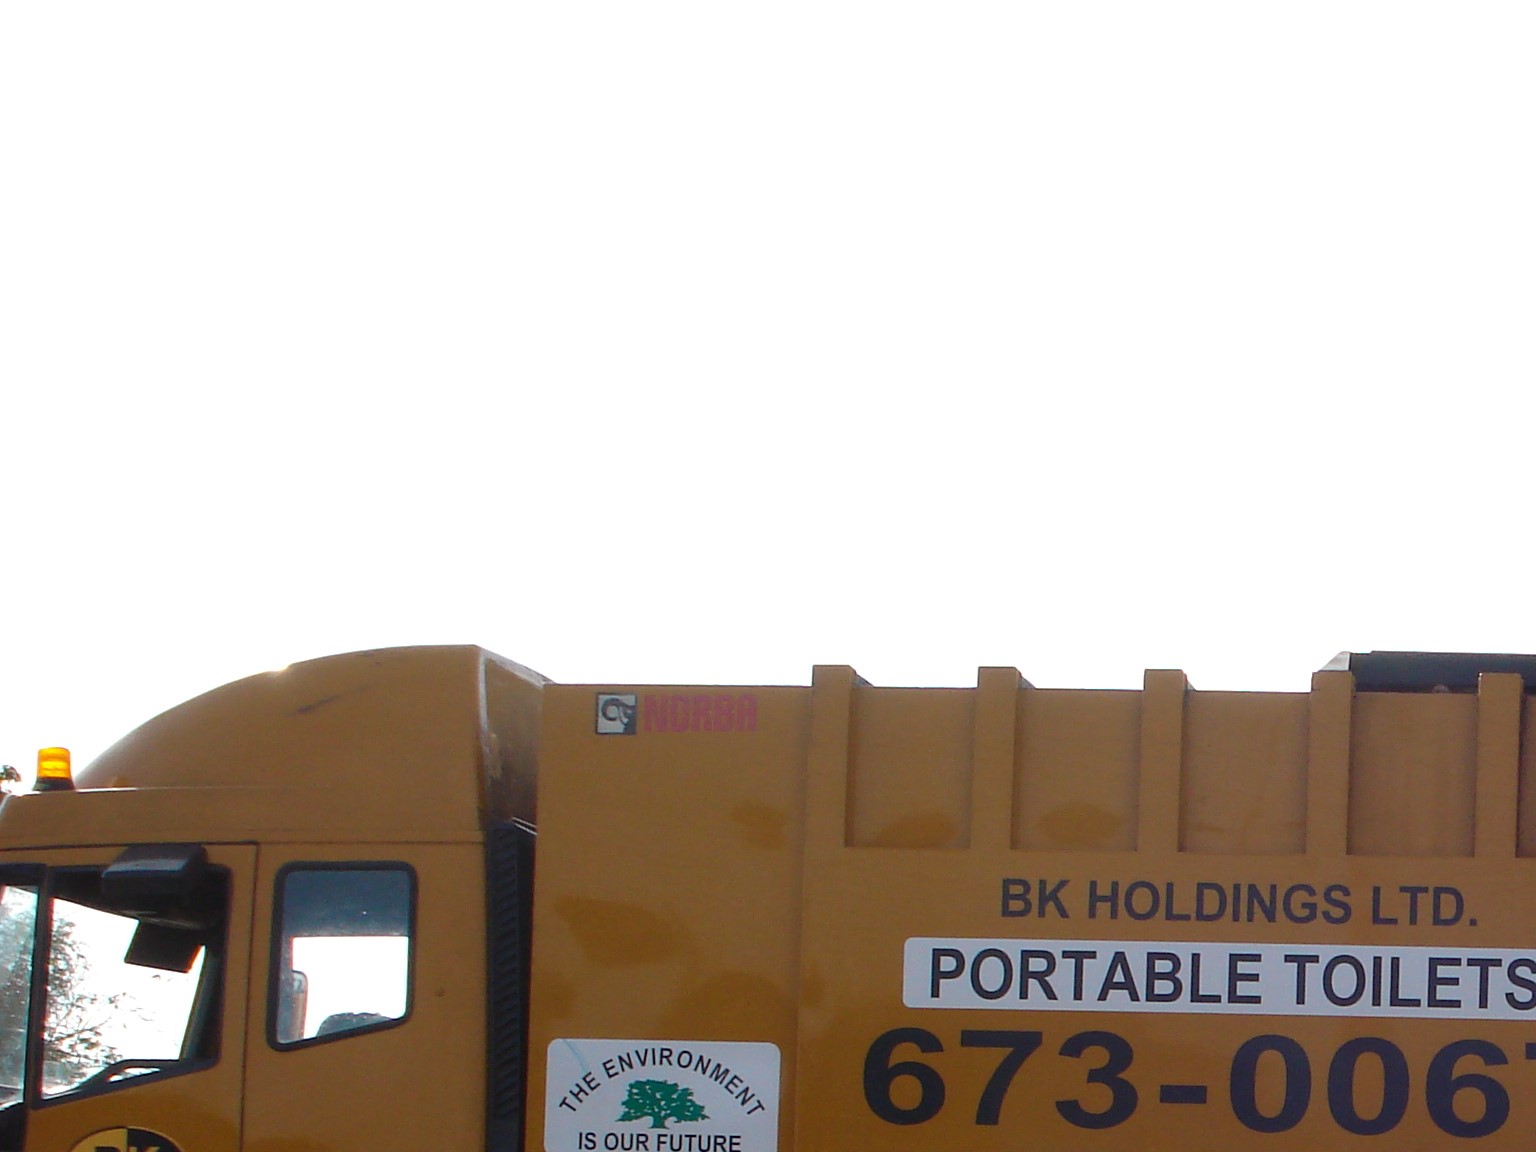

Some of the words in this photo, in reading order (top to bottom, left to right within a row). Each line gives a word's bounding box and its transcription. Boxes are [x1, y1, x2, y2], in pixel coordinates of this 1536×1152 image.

[643, 693, 758, 733] NORBA
[1001, 878, 1070, 919] BK
[1089, 880, 1352, 924] HOLDINGS
[1371, 886, 1478, 927] LTD.
[930, 947, 1262, 1005] PORTABLE
[559, 1072, 601, 1113] THE
[602, 1048, 765, 1116] ENVIRONMENT
[578, 1132, 597, 1150] IS
[604, 1132, 650, 1152] OUR
[656, 1134, 742, 1152] FUTURE
